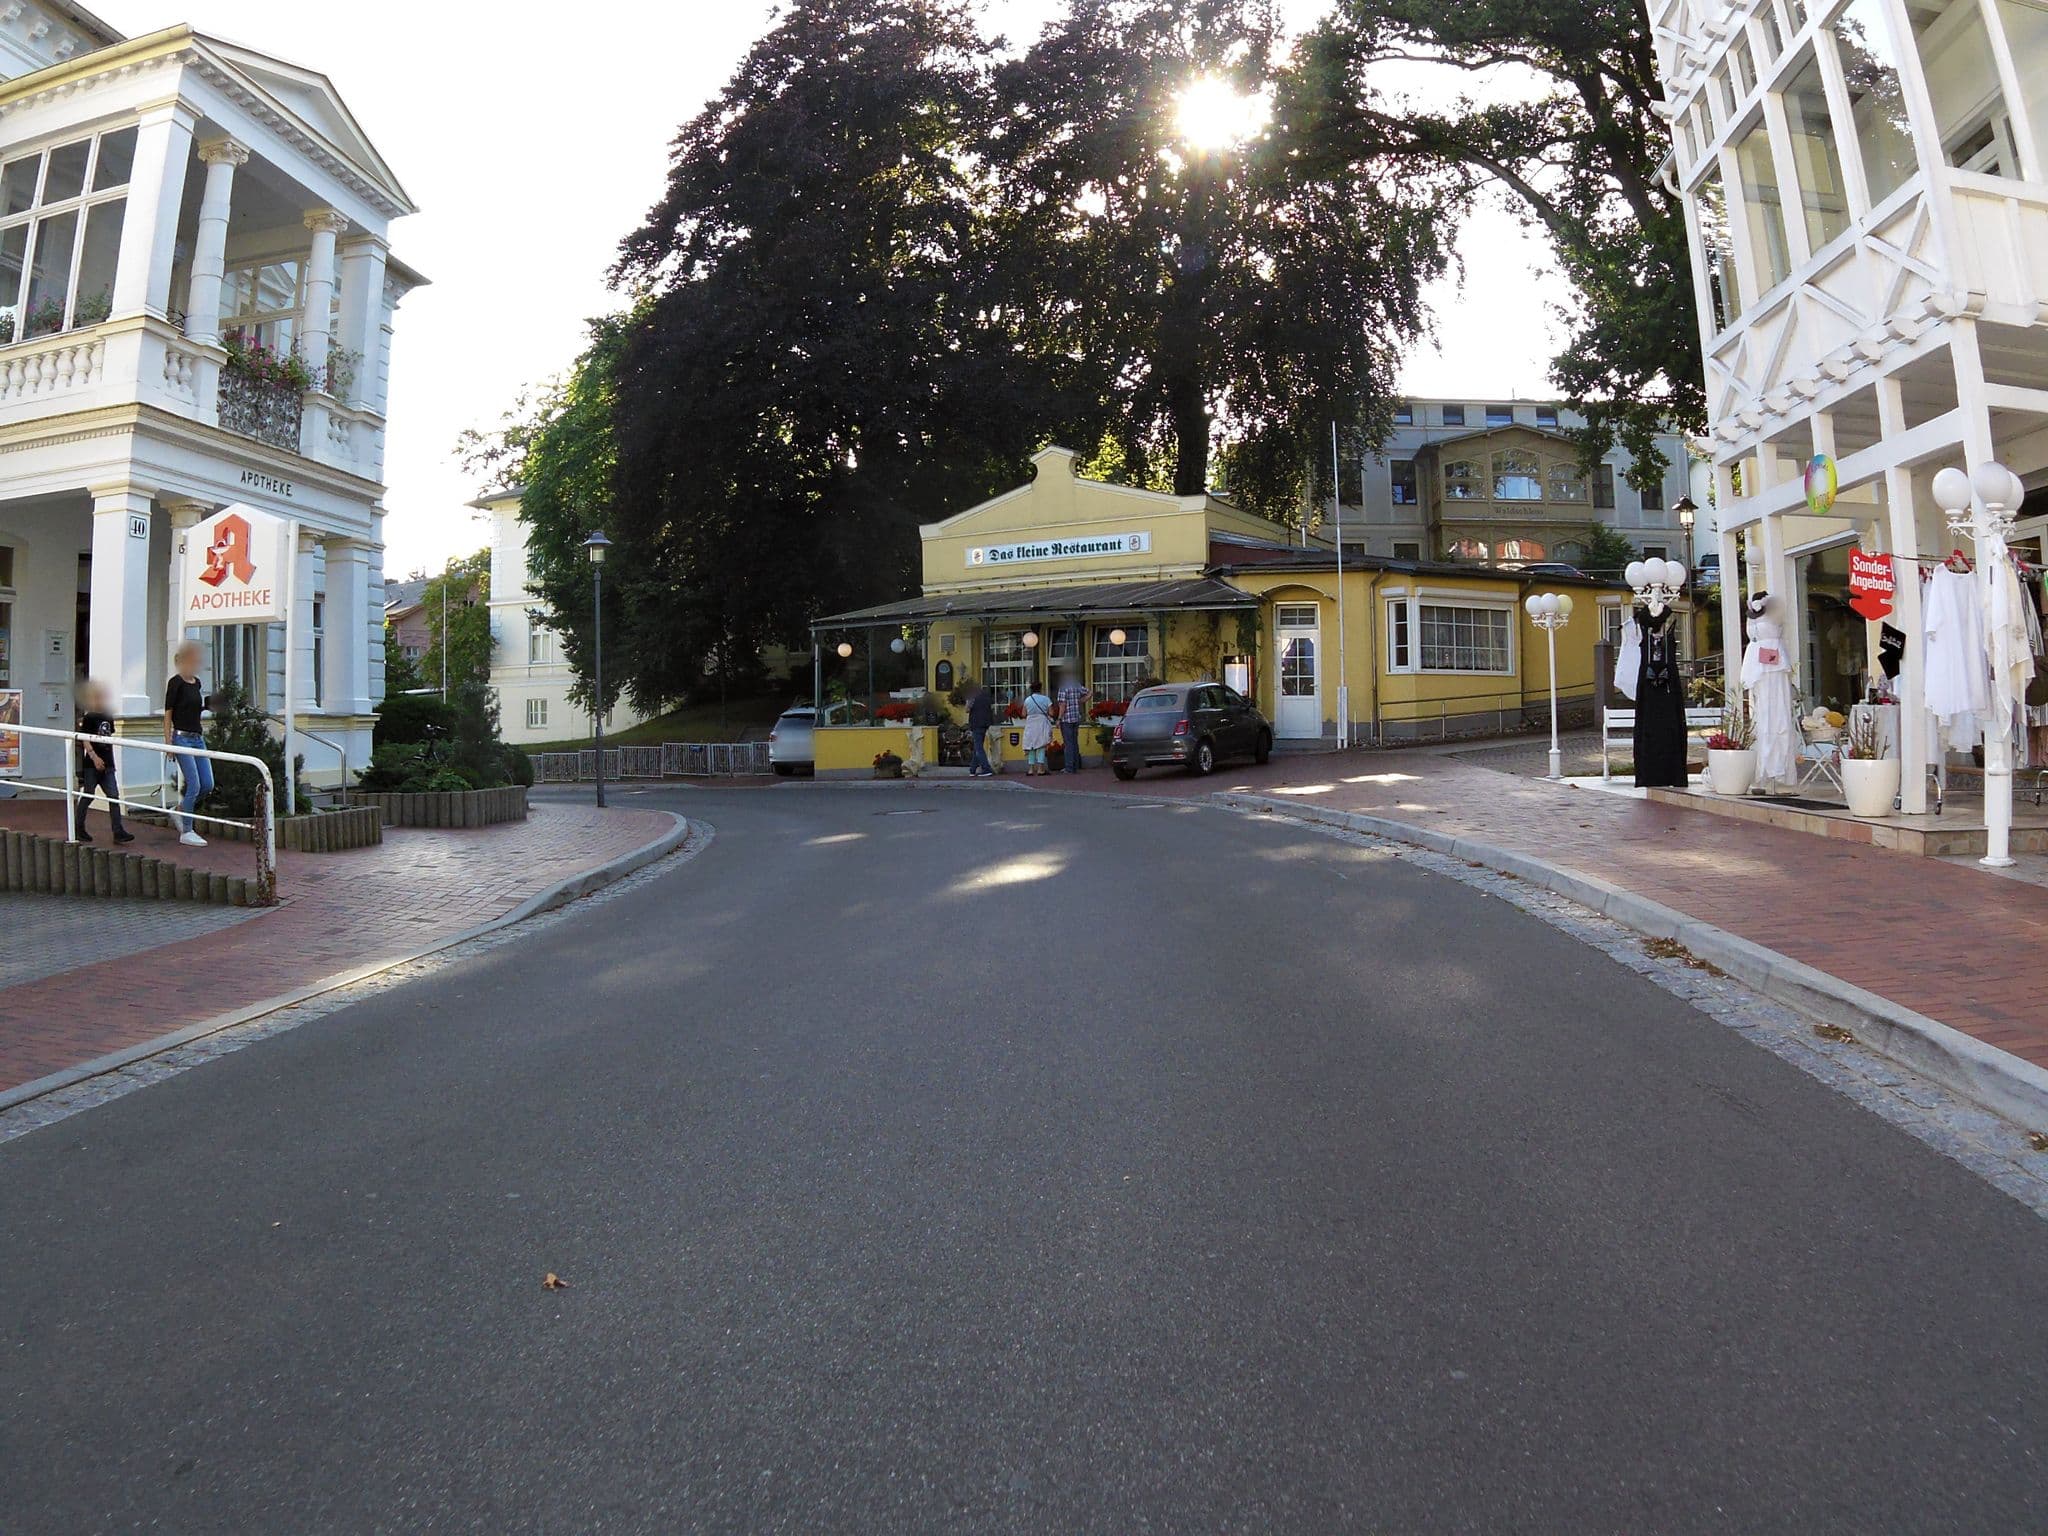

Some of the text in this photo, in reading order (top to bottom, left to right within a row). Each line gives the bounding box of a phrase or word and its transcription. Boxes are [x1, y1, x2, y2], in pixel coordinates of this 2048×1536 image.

[240, 470, 293, 497] APOTHEKE
[131, 519, 145, 536] 40
[989, 538, 1122, 561] Das kleine Restaurant
[1852, 555, 1892, 575] Sonder-
[1850, 571, 1894, 592] Angebote
[190, 589, 271, 610] APOTHEKE
